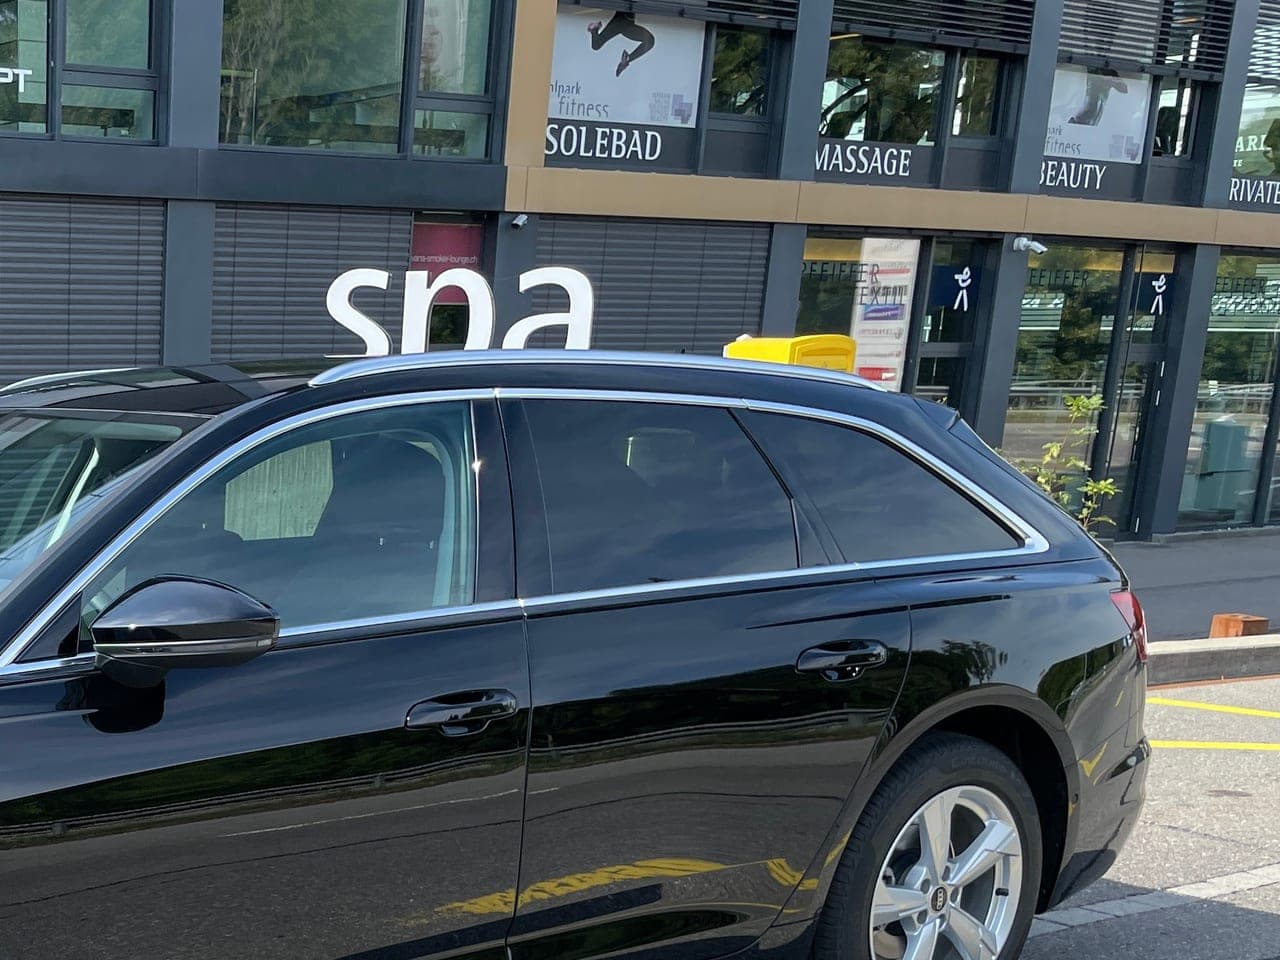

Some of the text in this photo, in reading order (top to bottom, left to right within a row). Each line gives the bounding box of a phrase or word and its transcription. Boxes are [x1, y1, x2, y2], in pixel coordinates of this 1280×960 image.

[558, 95, 609, 118] fitness
[544, 123, 663, 161] SOLEBAD
[815, 143, 912, 176] MASSAGE
